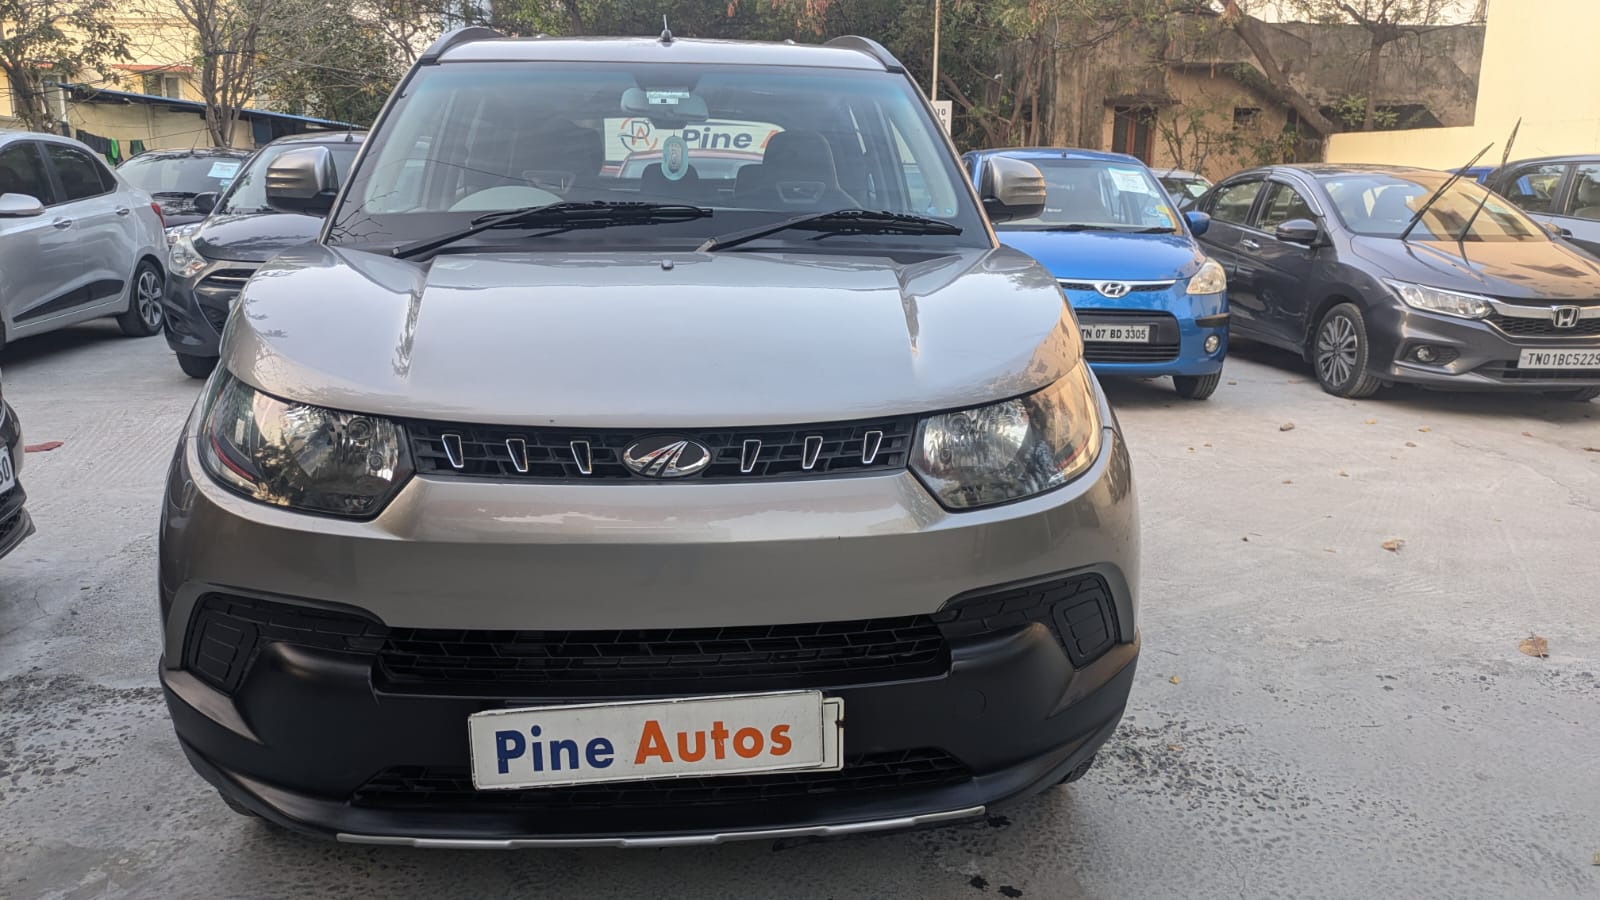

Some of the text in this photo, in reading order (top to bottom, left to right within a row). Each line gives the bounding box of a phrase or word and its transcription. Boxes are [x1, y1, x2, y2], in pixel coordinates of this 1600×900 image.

[682, 126, 753, 149] Pine
[1081, 328, 1146, 339] TN 07 BD 3305
[495, 719, 793, 775] Pine Autos
